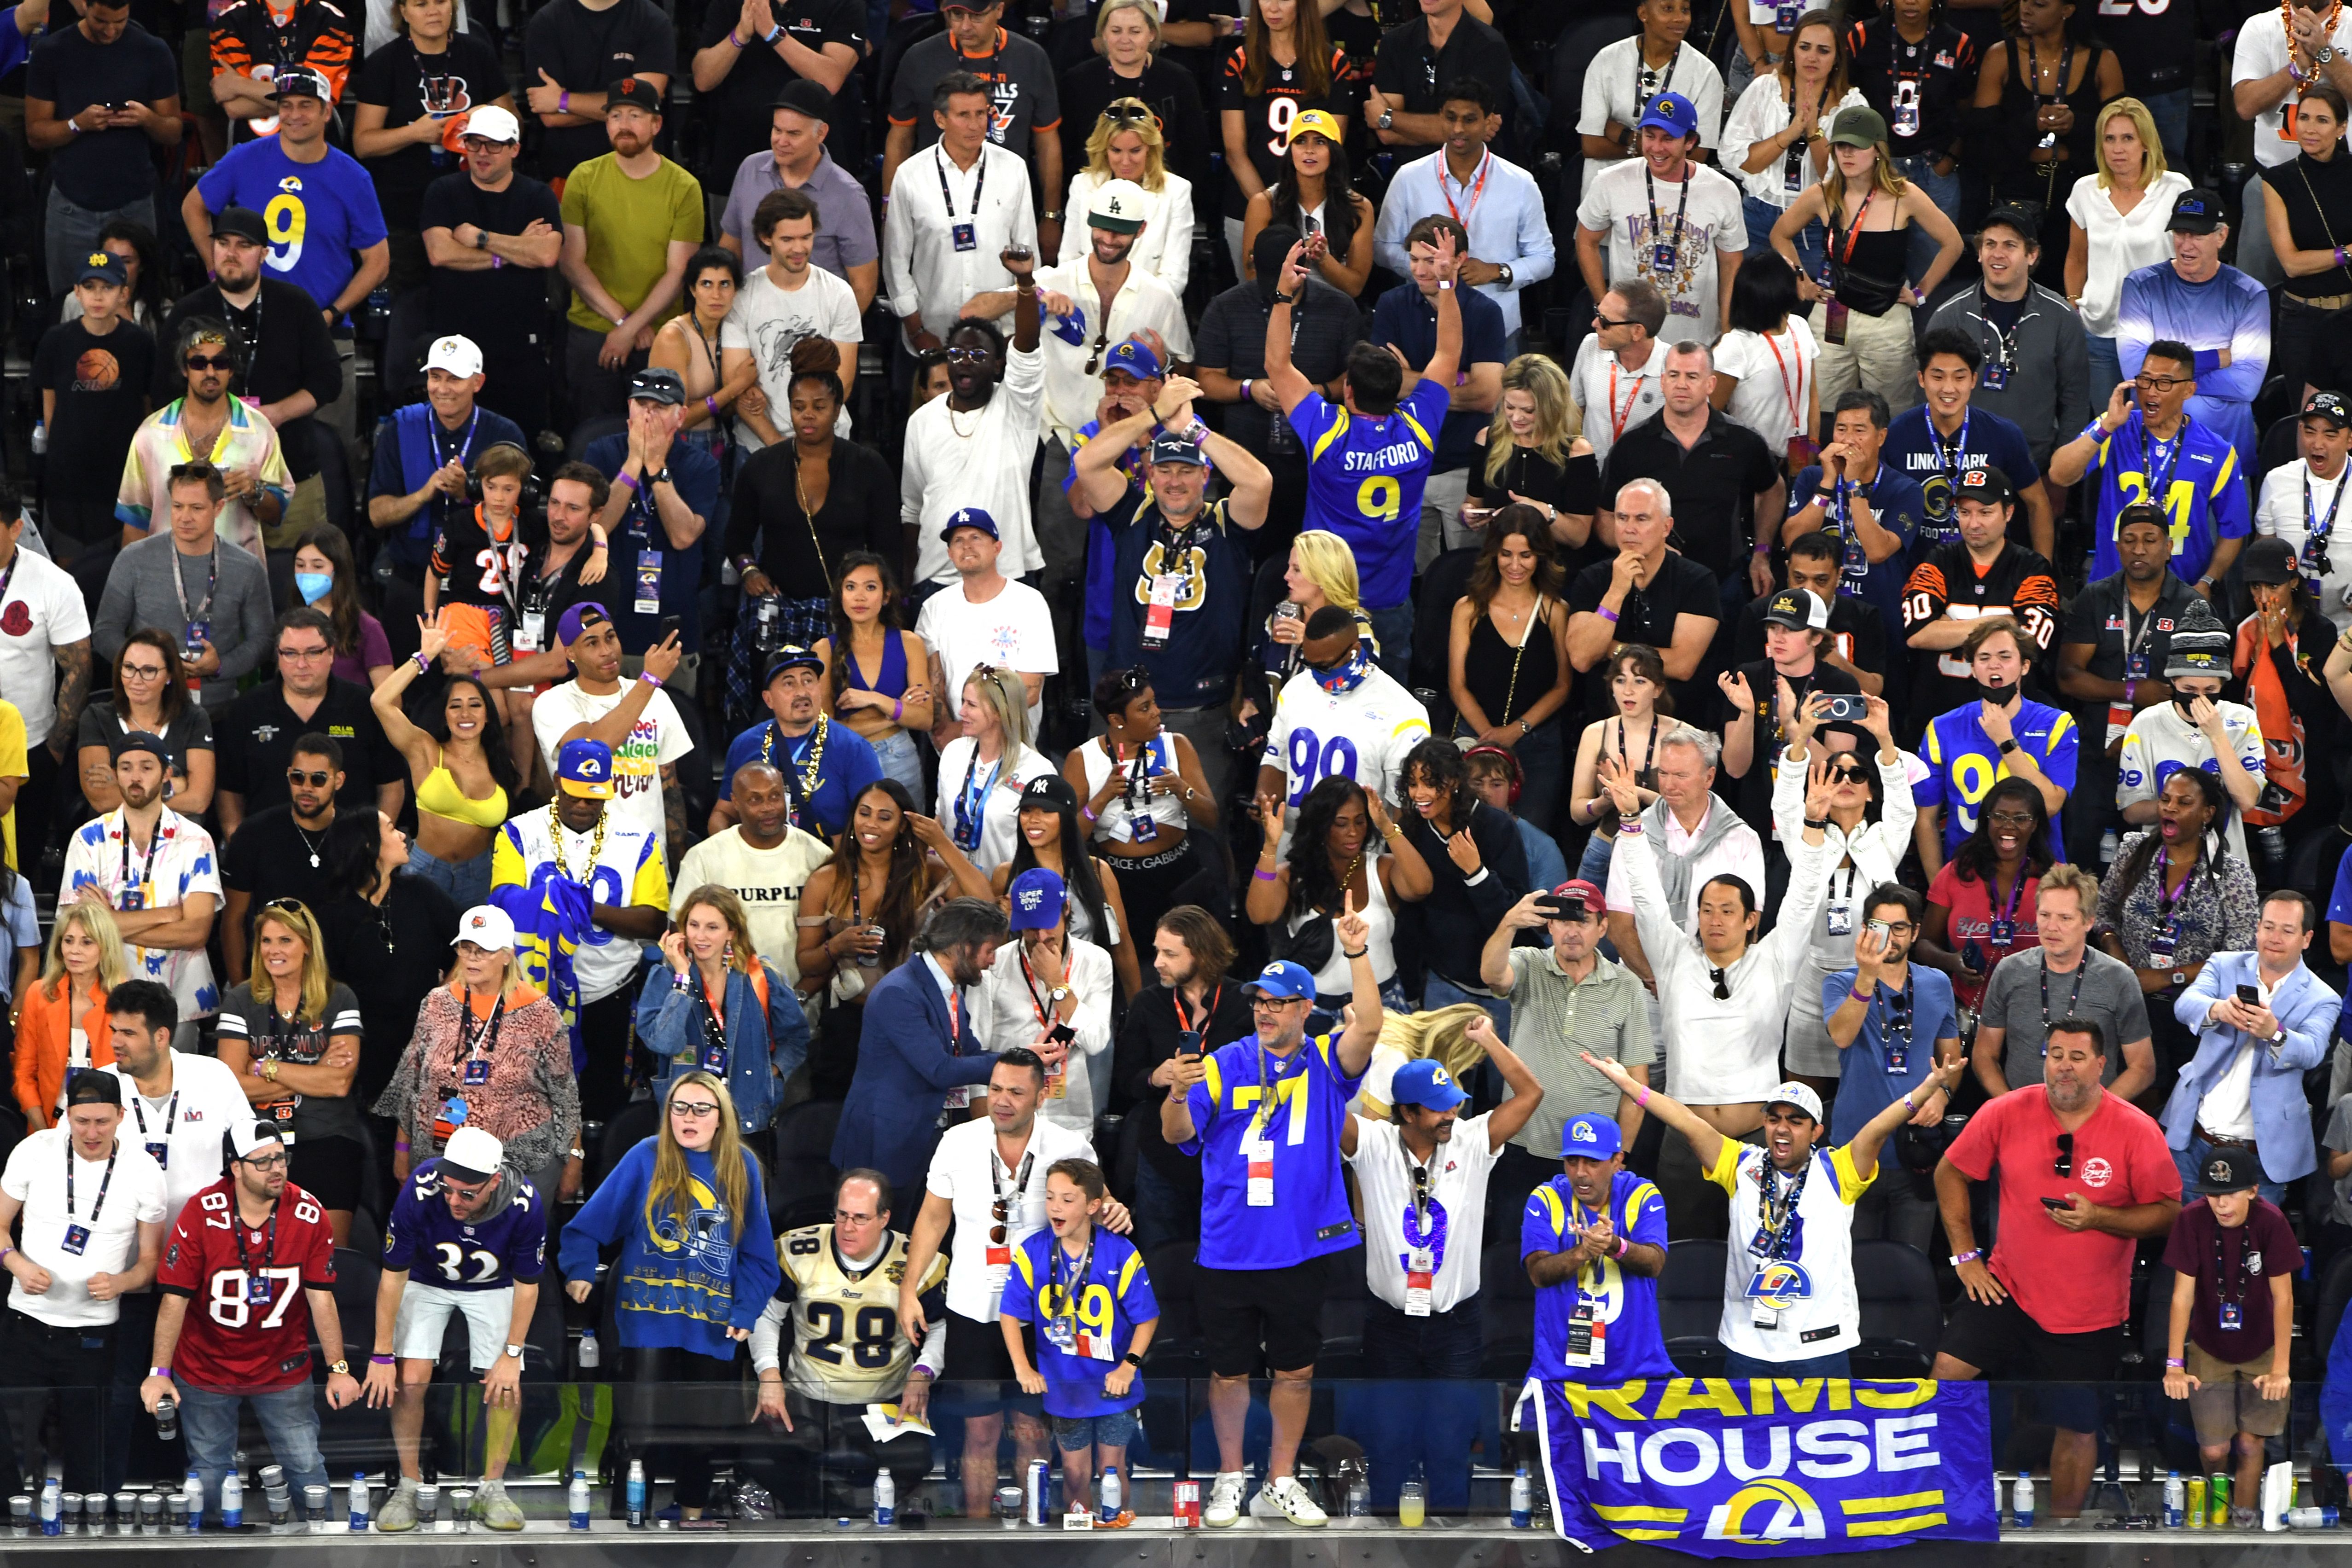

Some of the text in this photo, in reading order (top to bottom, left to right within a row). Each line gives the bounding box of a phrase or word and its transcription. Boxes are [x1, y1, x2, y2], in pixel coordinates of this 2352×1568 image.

[264, 194, 306, 273] 9
[1344, 441, 1419, 470] STAFFORD
[1356, 475, 1401, 523] 9
[2022, 606, 2055, 650] 30
[1142, 841, 1190, 870] GABBANA
[1019, 890, 1043, 899] SUPER
[1020, 897, 1042, 906] BOWL
[200, 1191, 231, 1229] 87
[1399, 1197, 1448, 1276] 9
[435, 1243, 500, 1283] 32
[210, 1267, 301, 1328] 87
[805, 1301, 897, 1369] 28
[1582, 1412, 1941, 1487] HOUSE
